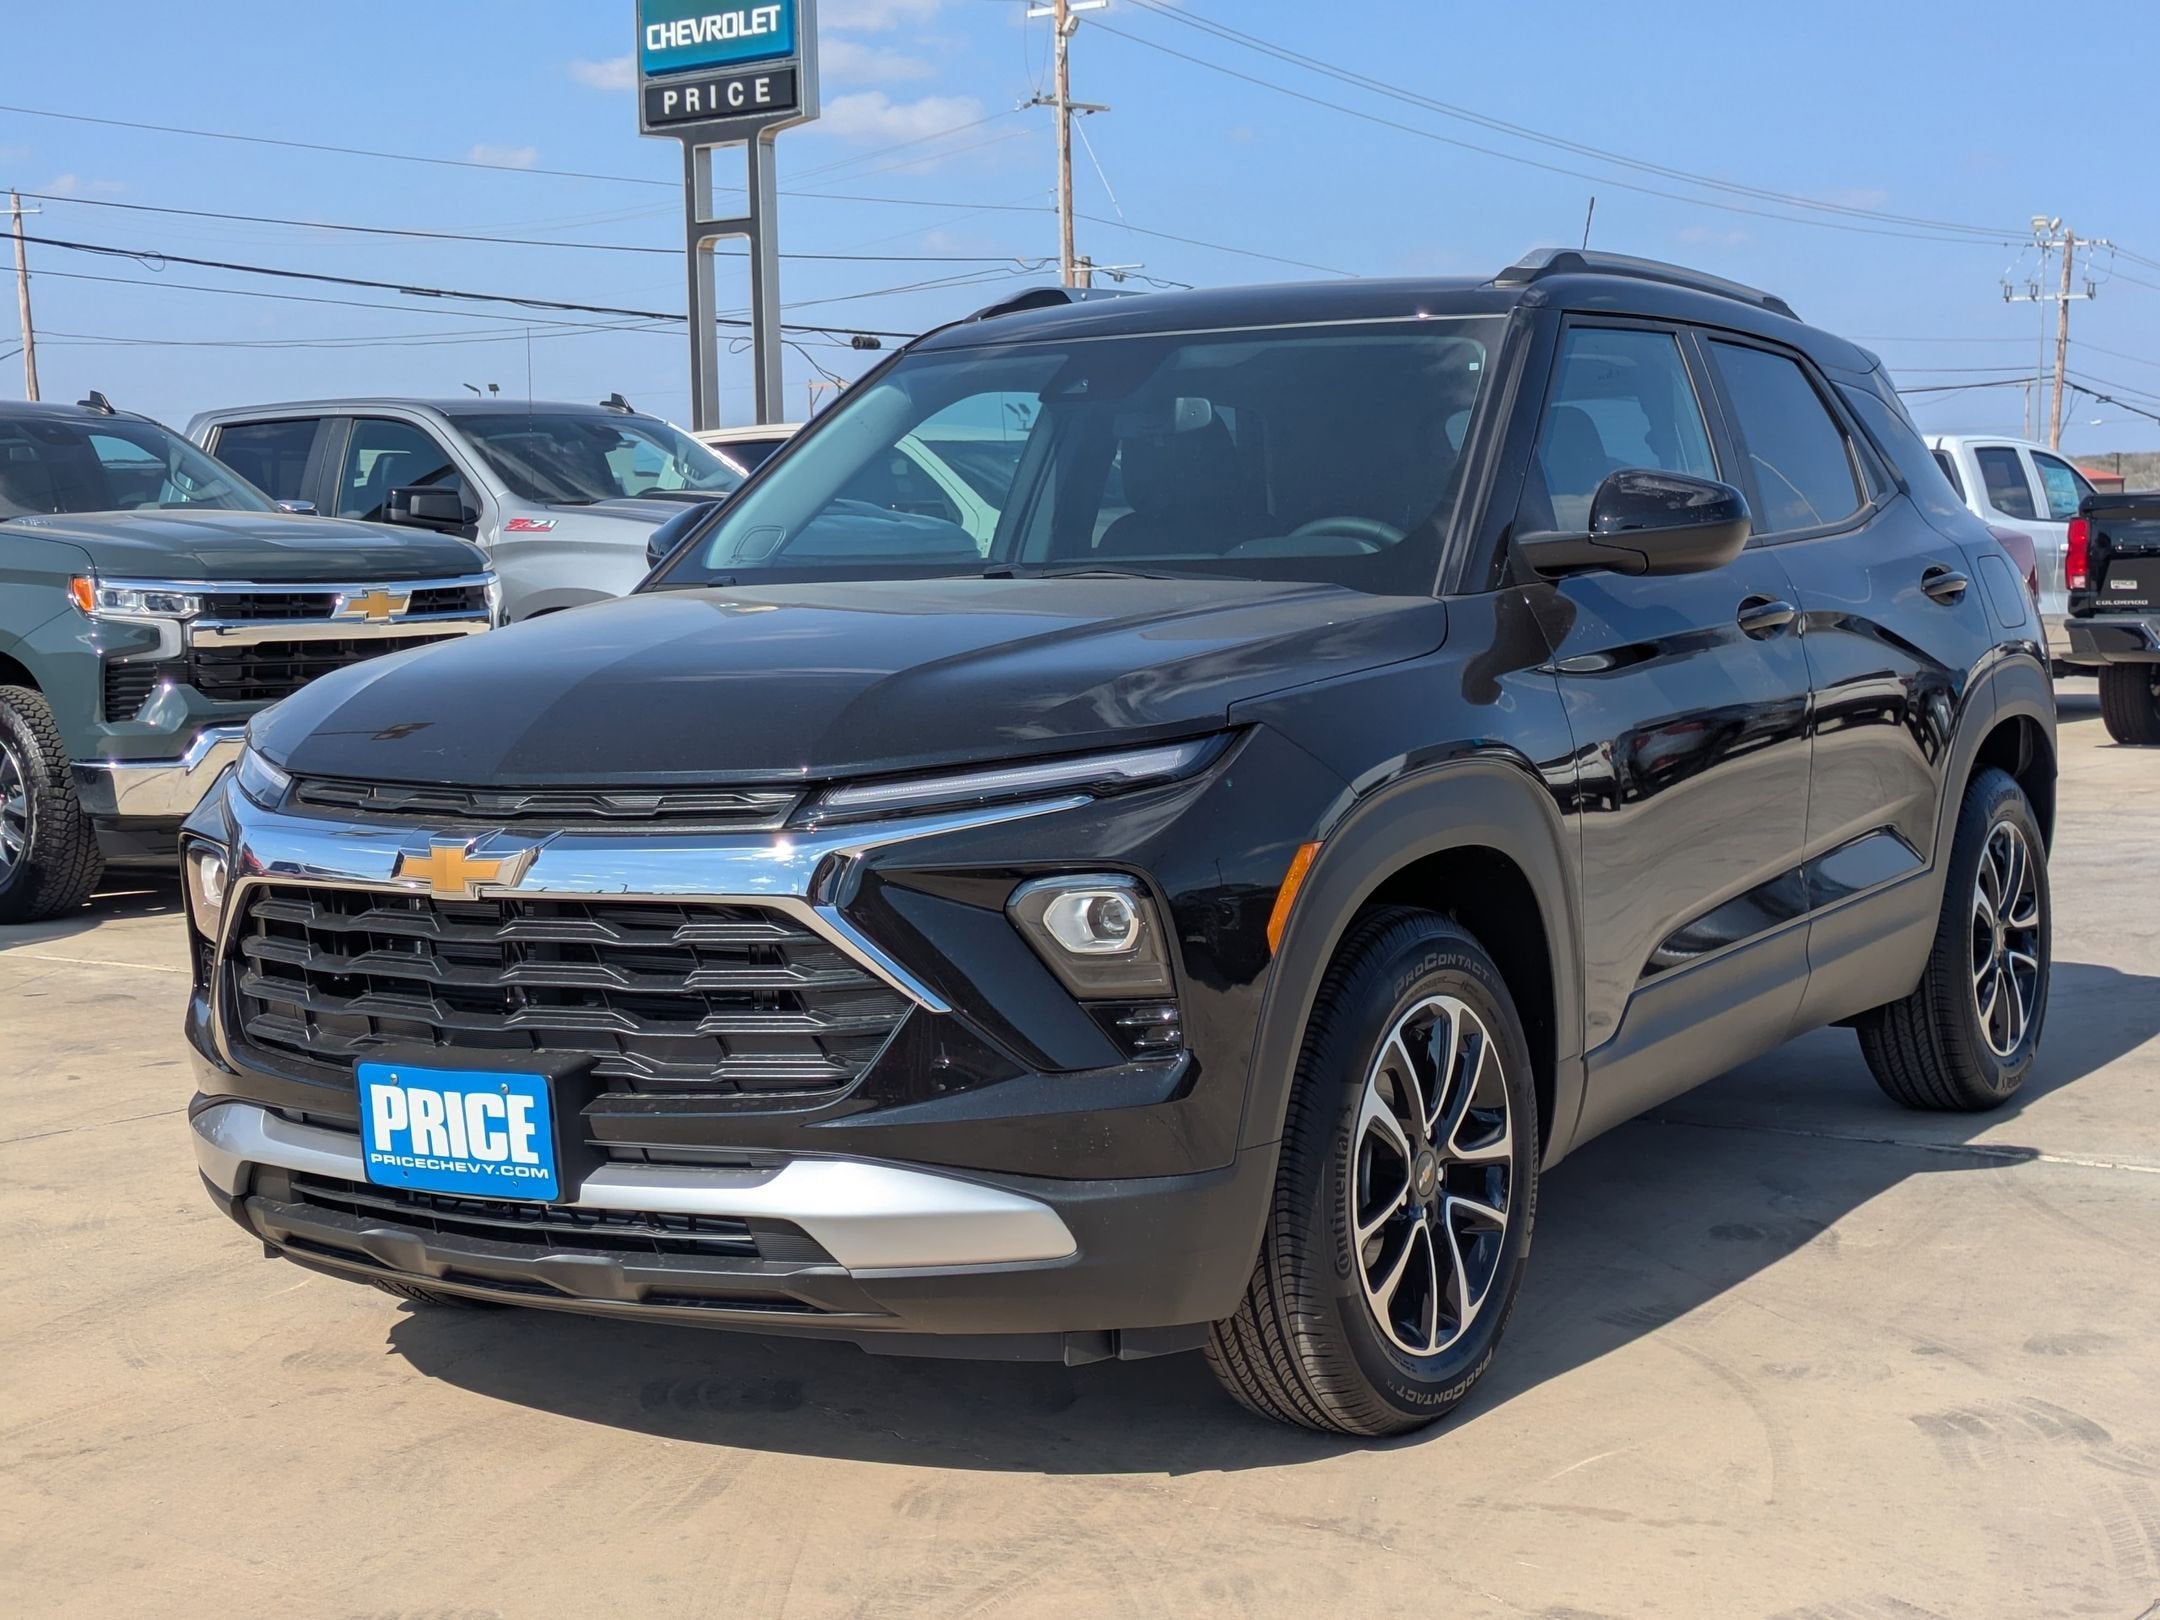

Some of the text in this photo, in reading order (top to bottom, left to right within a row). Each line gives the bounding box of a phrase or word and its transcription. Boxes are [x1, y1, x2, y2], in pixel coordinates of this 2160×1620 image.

[646, 5, 781, 50] CHEVROLET
[663, 77, 770, 115] PRICE
[370, 1084, 539, 1164] PRICE
[371, 1152, 549, 1180] PRICECHEVY.COM
